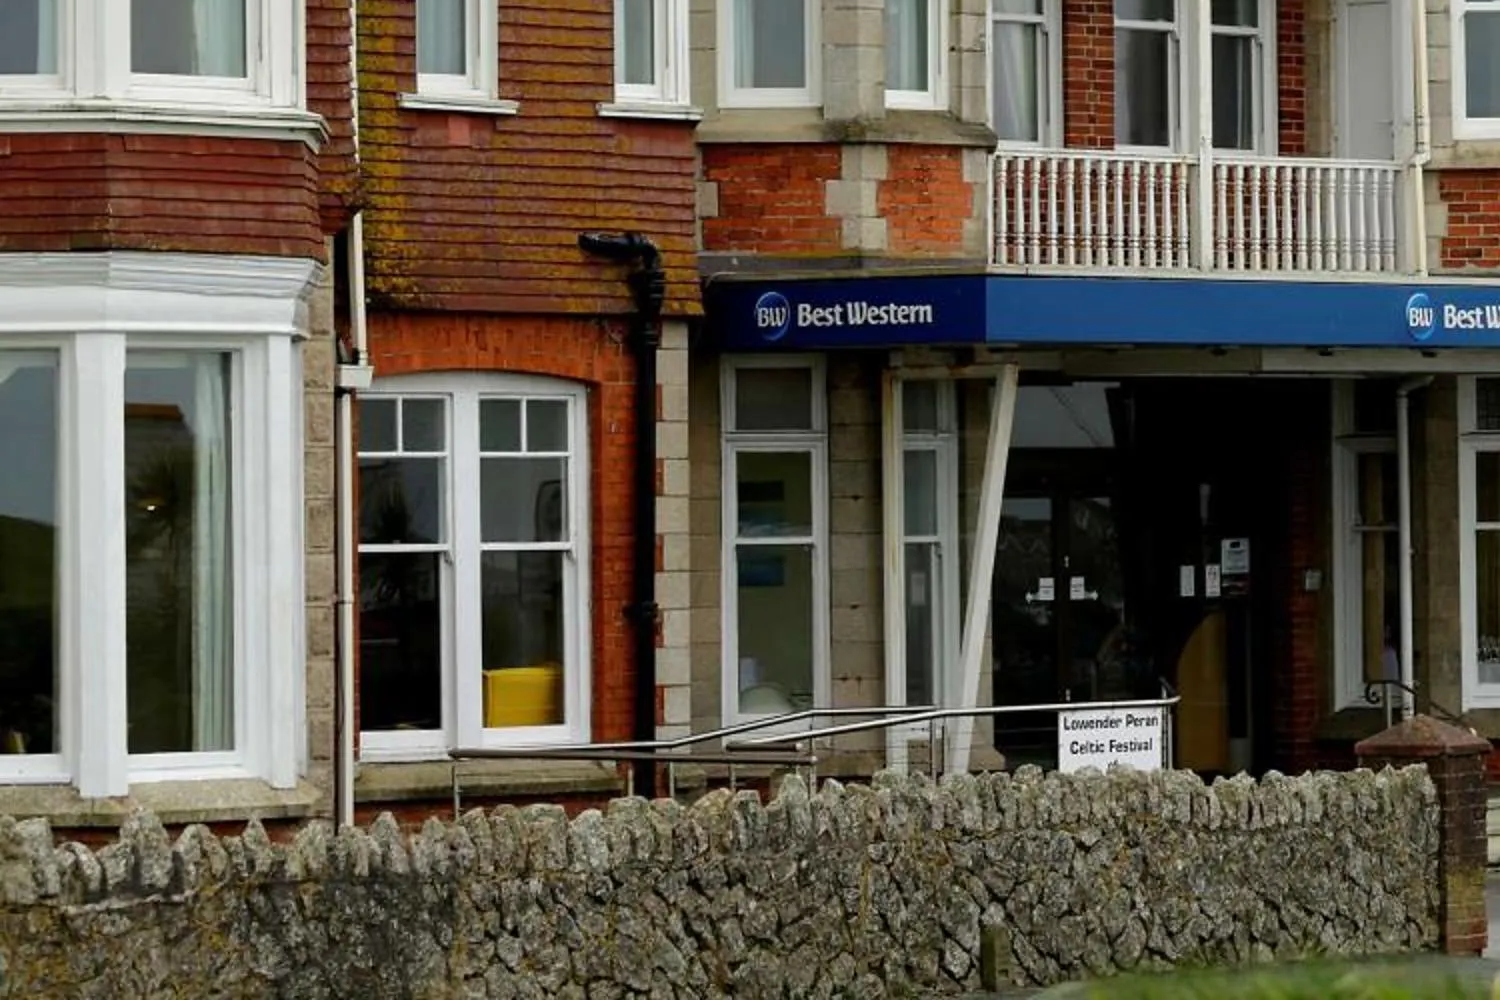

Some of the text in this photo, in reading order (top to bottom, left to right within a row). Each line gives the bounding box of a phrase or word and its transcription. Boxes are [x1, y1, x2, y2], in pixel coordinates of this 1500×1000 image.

[757, 307, 786, 328] BW
[797, 301, 933, 327] Best Western
[1409, 309, 1434, 327] BW
[1443, 304, 1484, 329] Best
[1063, 714, 1159, 731] Lowender Peran
[1069, 737, 1153, 755] Celtic Festival
